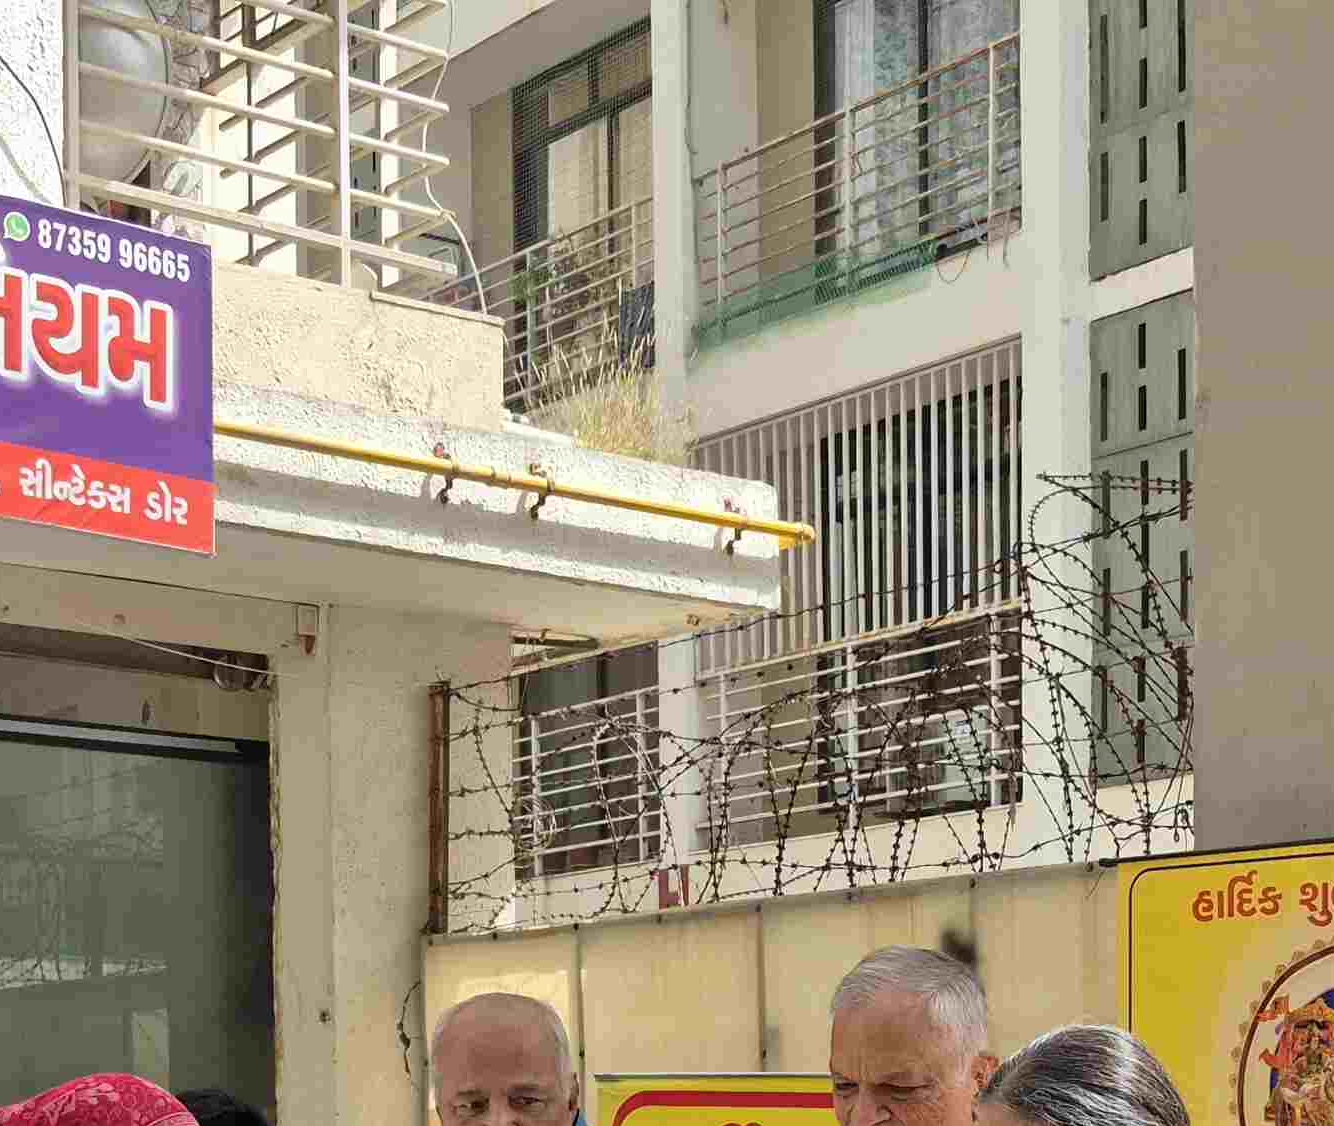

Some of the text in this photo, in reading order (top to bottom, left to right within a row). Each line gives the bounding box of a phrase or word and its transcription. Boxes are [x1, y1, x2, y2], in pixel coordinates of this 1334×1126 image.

[37, 218, 191, 282] 87359 96665
[144, 481, 188, 525] ડોર
[1192, 870, 1284, 923] હાર્દિક
